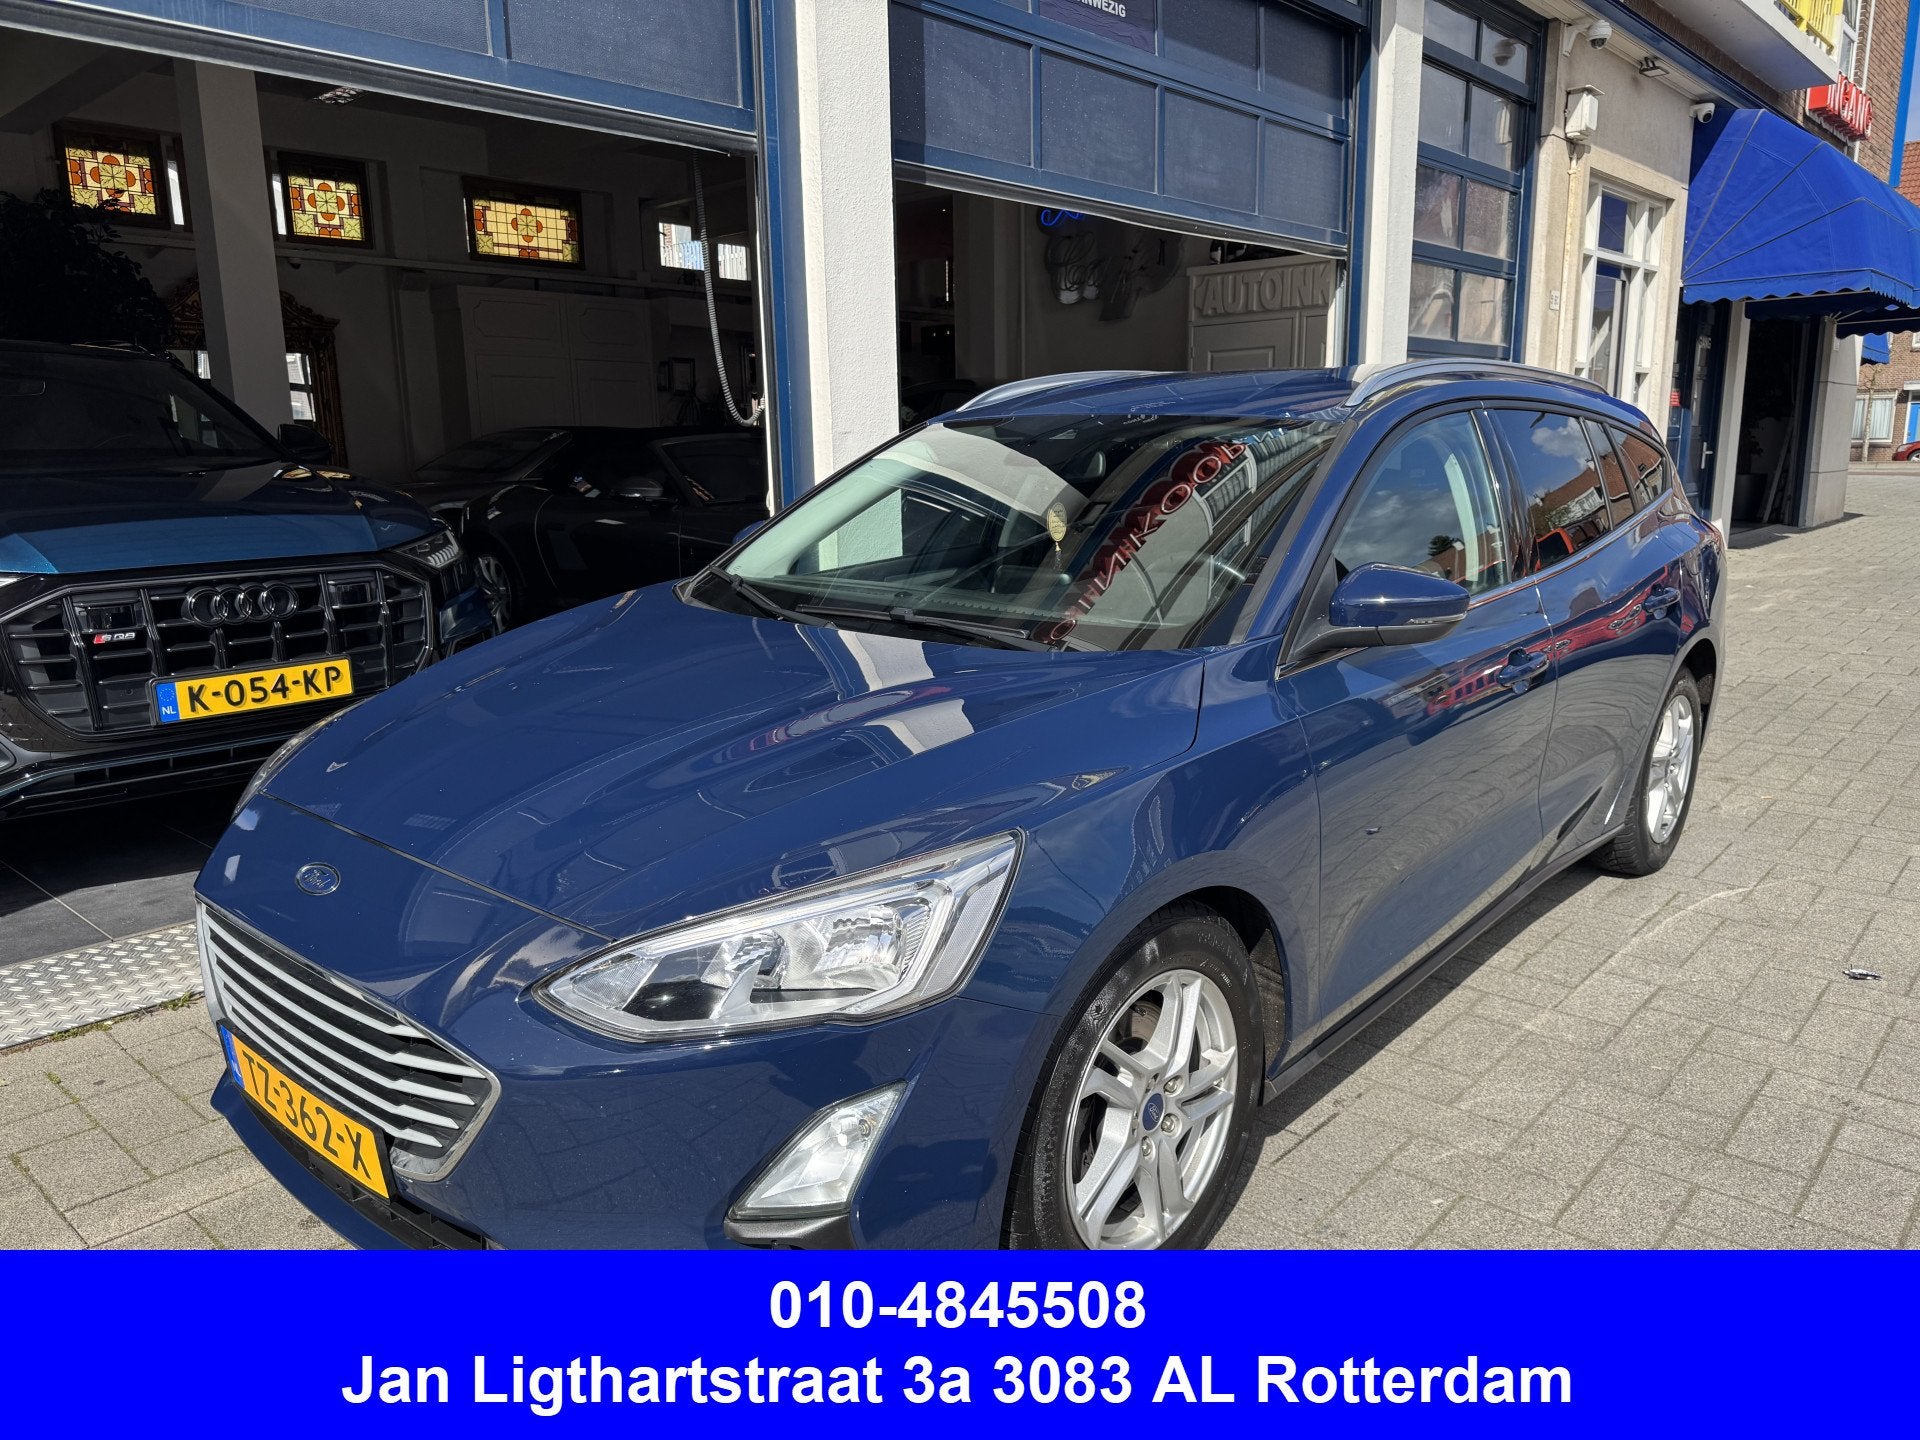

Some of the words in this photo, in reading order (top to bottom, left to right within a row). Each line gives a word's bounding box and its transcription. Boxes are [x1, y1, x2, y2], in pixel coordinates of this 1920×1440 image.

[1078, 0, 1126, 17] WEZIG
[187, 666, 341, 713] K-054-KP
[162, 705, 176, 715] NL
[242, 1050, 372, 1180] TZ-362-X
